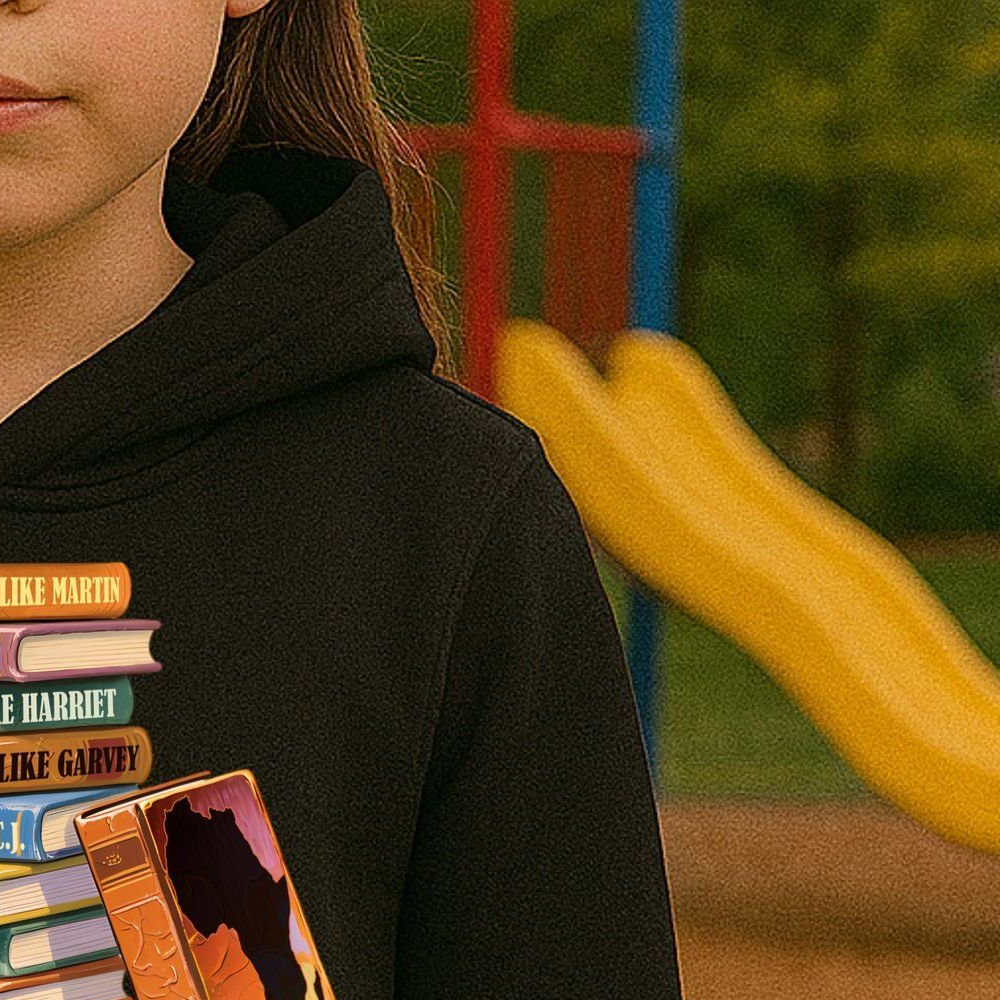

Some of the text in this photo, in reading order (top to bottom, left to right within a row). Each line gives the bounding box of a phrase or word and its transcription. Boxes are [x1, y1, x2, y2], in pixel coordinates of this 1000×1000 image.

[52, 576, 121, 606] MARTIN
[21, 688, 117, 723] HARRIET
[57, 744, 140, 777] GARVEY
